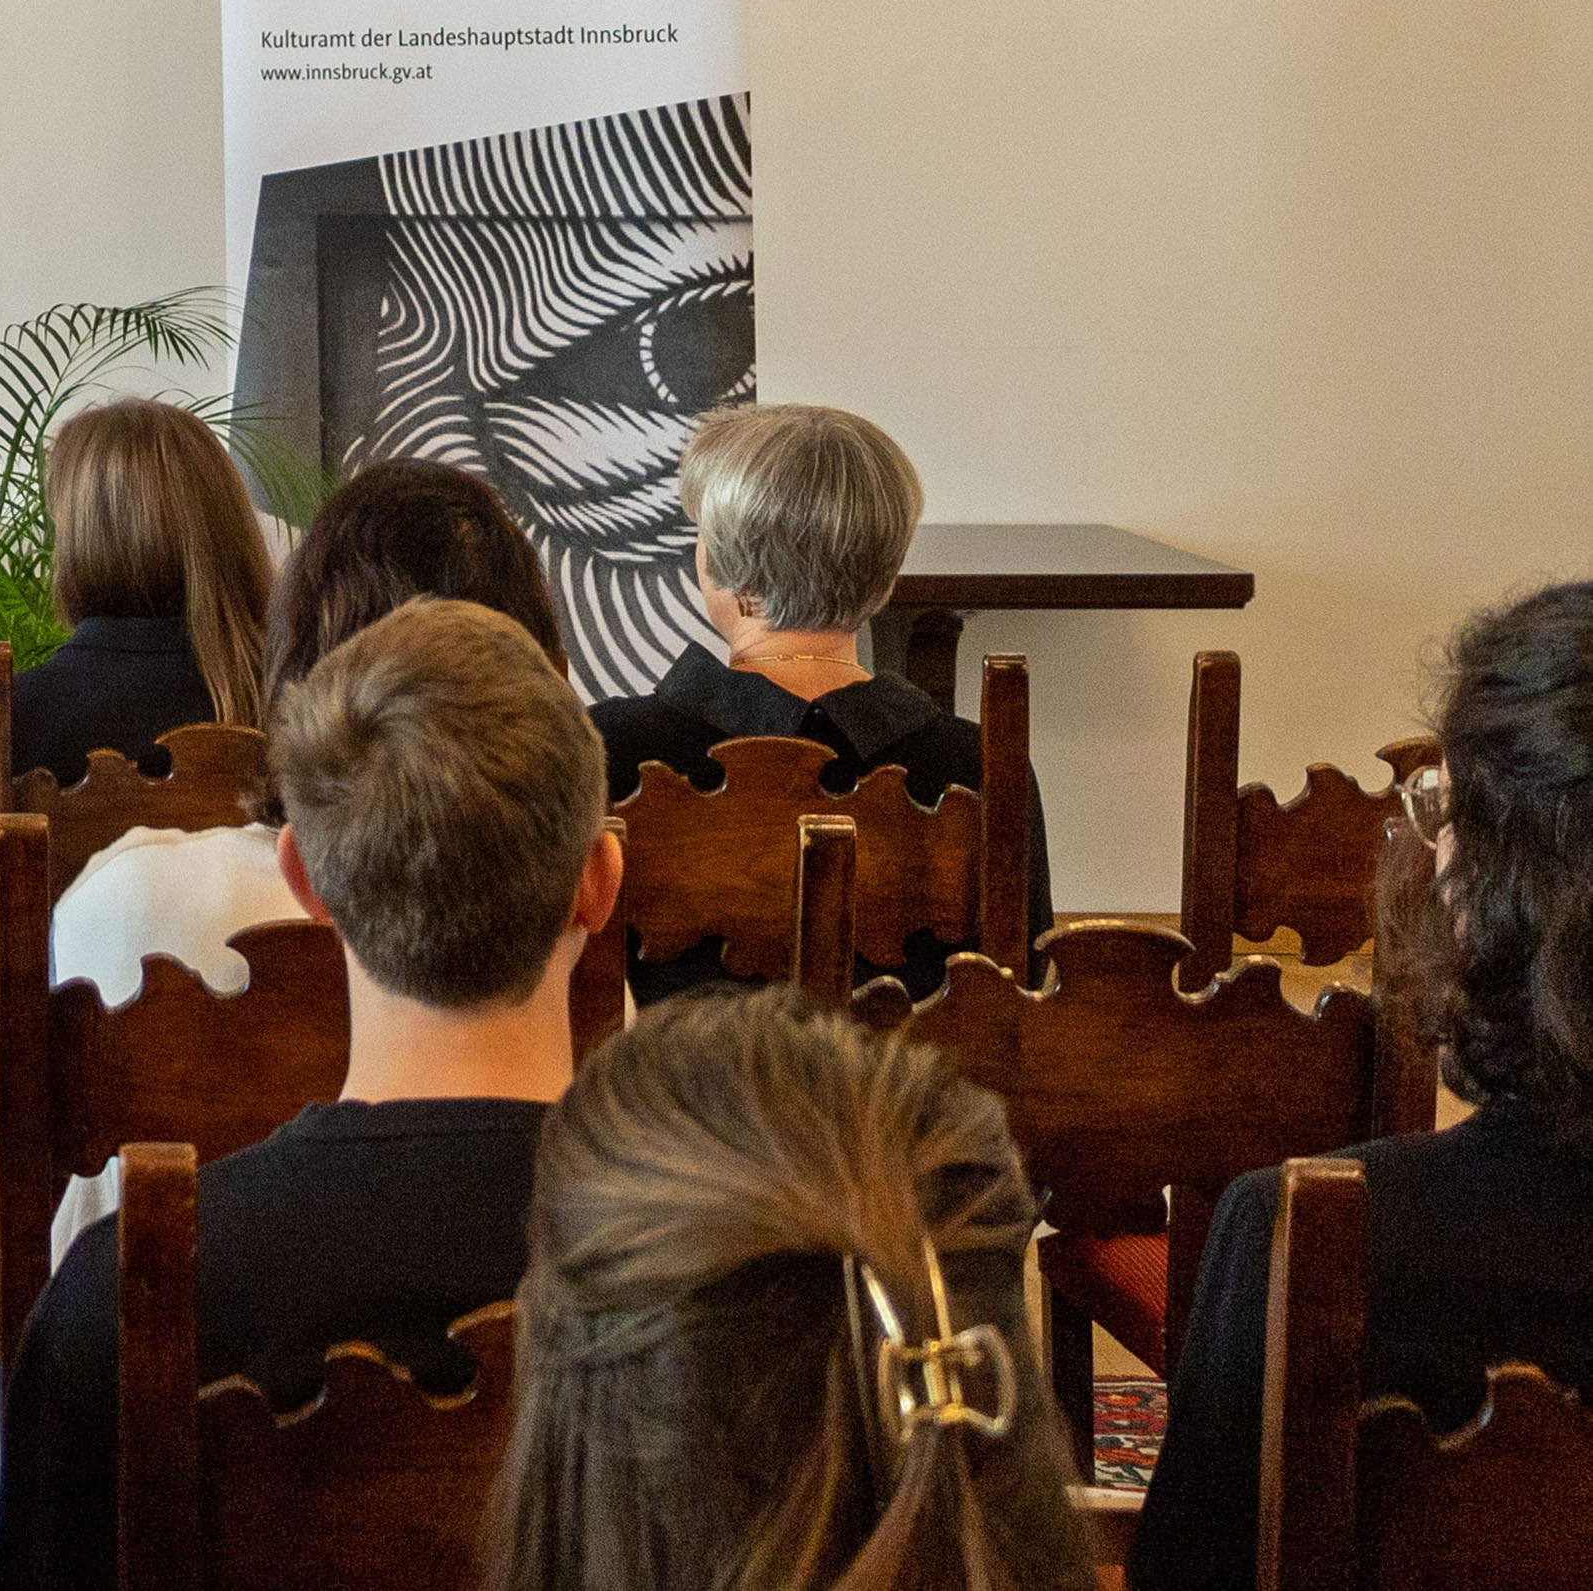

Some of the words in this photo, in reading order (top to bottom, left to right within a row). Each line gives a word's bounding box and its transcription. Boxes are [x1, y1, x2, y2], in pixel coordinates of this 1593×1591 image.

[261, 29, 356, 49] Kulturamt
[360, 28, 393, 48] der
[398, 24, 575, 51] Landeshauptstadt
[580, 23, 679, 44] Innsbruck
[260, 62, 433, 85] www.innsbruck.gv.at
